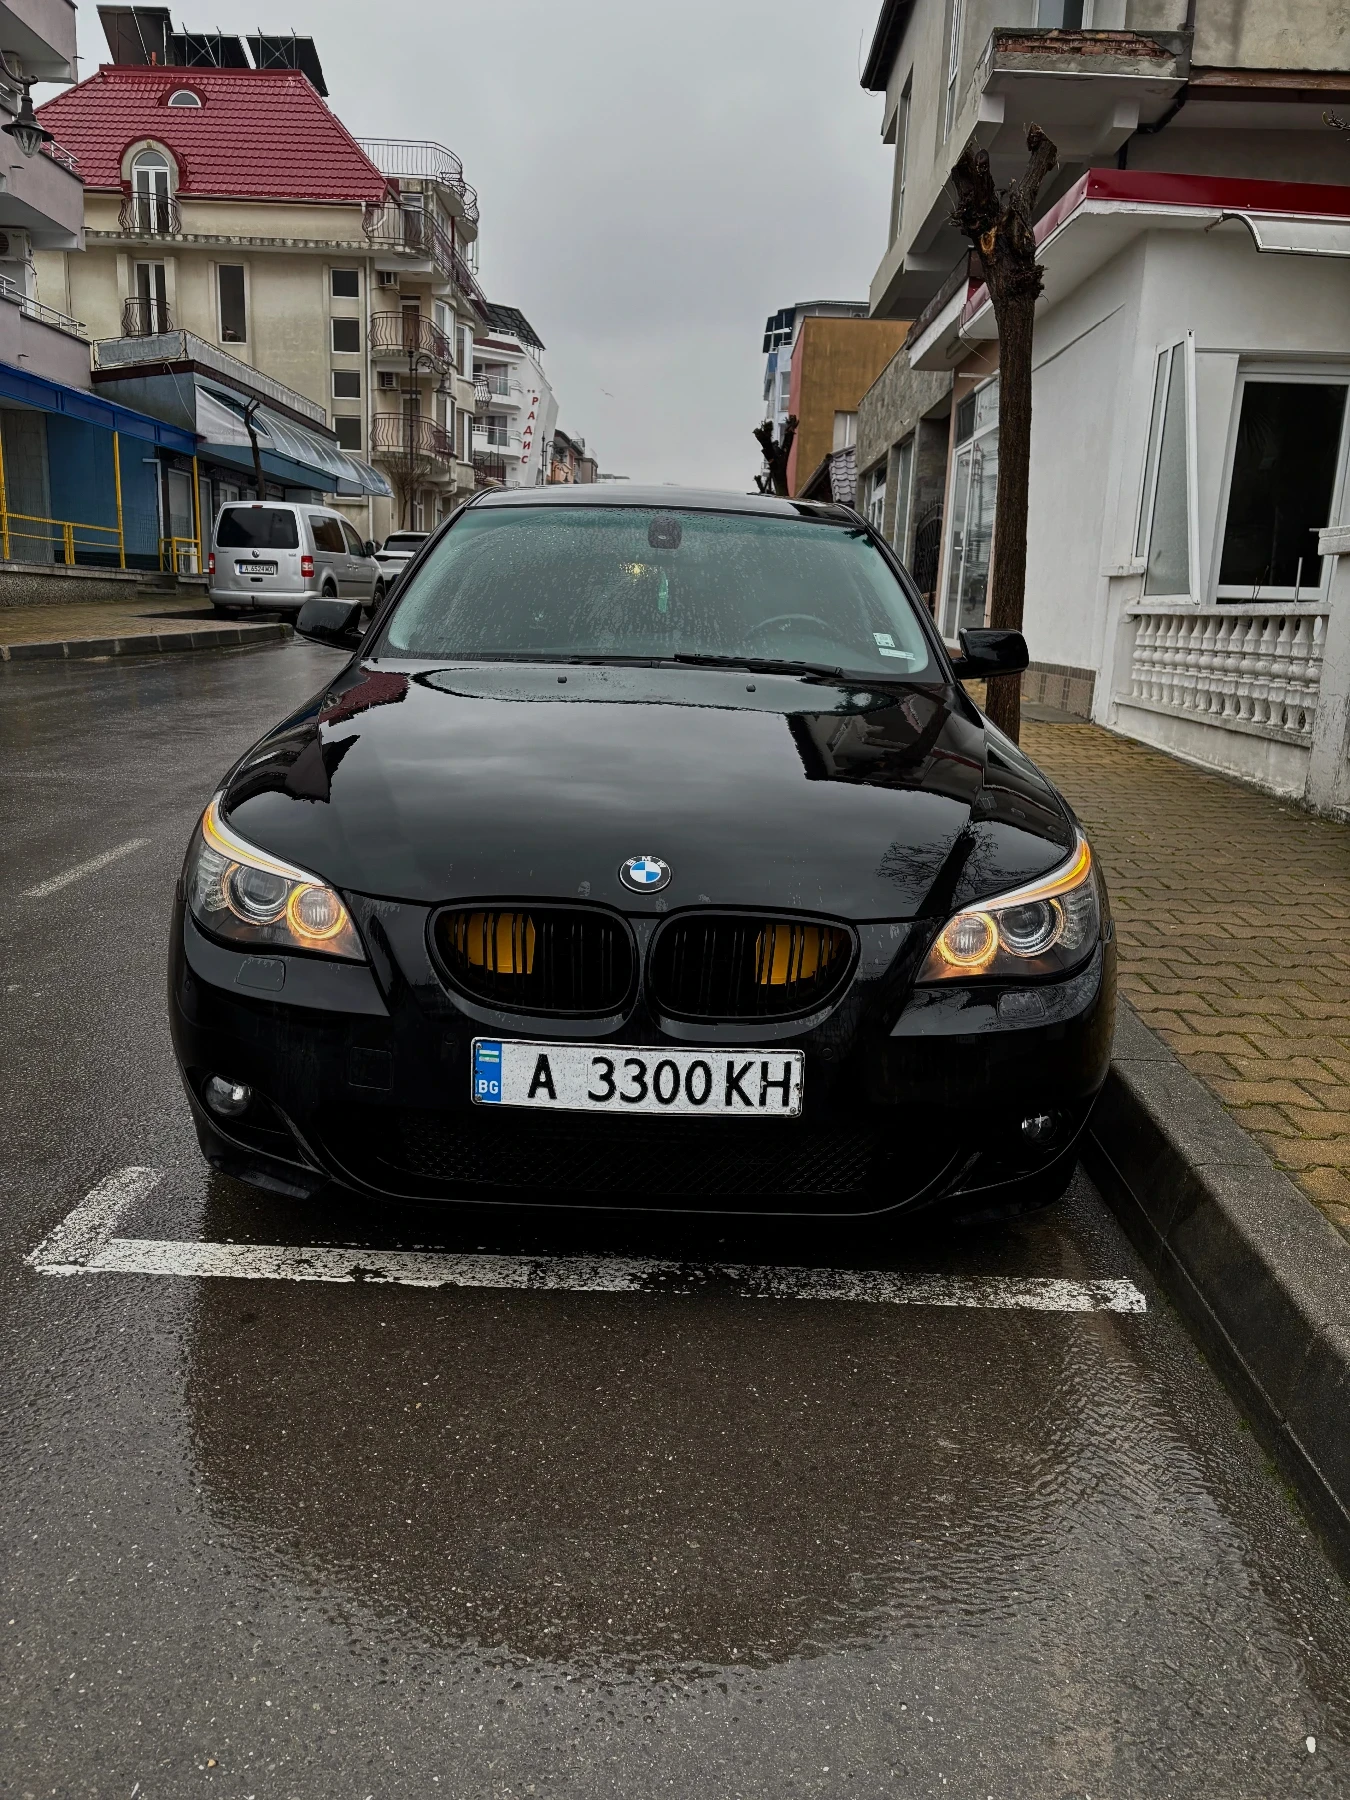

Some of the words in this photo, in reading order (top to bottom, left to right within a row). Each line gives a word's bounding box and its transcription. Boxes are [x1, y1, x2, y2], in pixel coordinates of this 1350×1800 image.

[520, 396, 539, 464] РАДИС
[478, 1079, 499, 1095] BG
[527, 1053, 557, 1100] A
